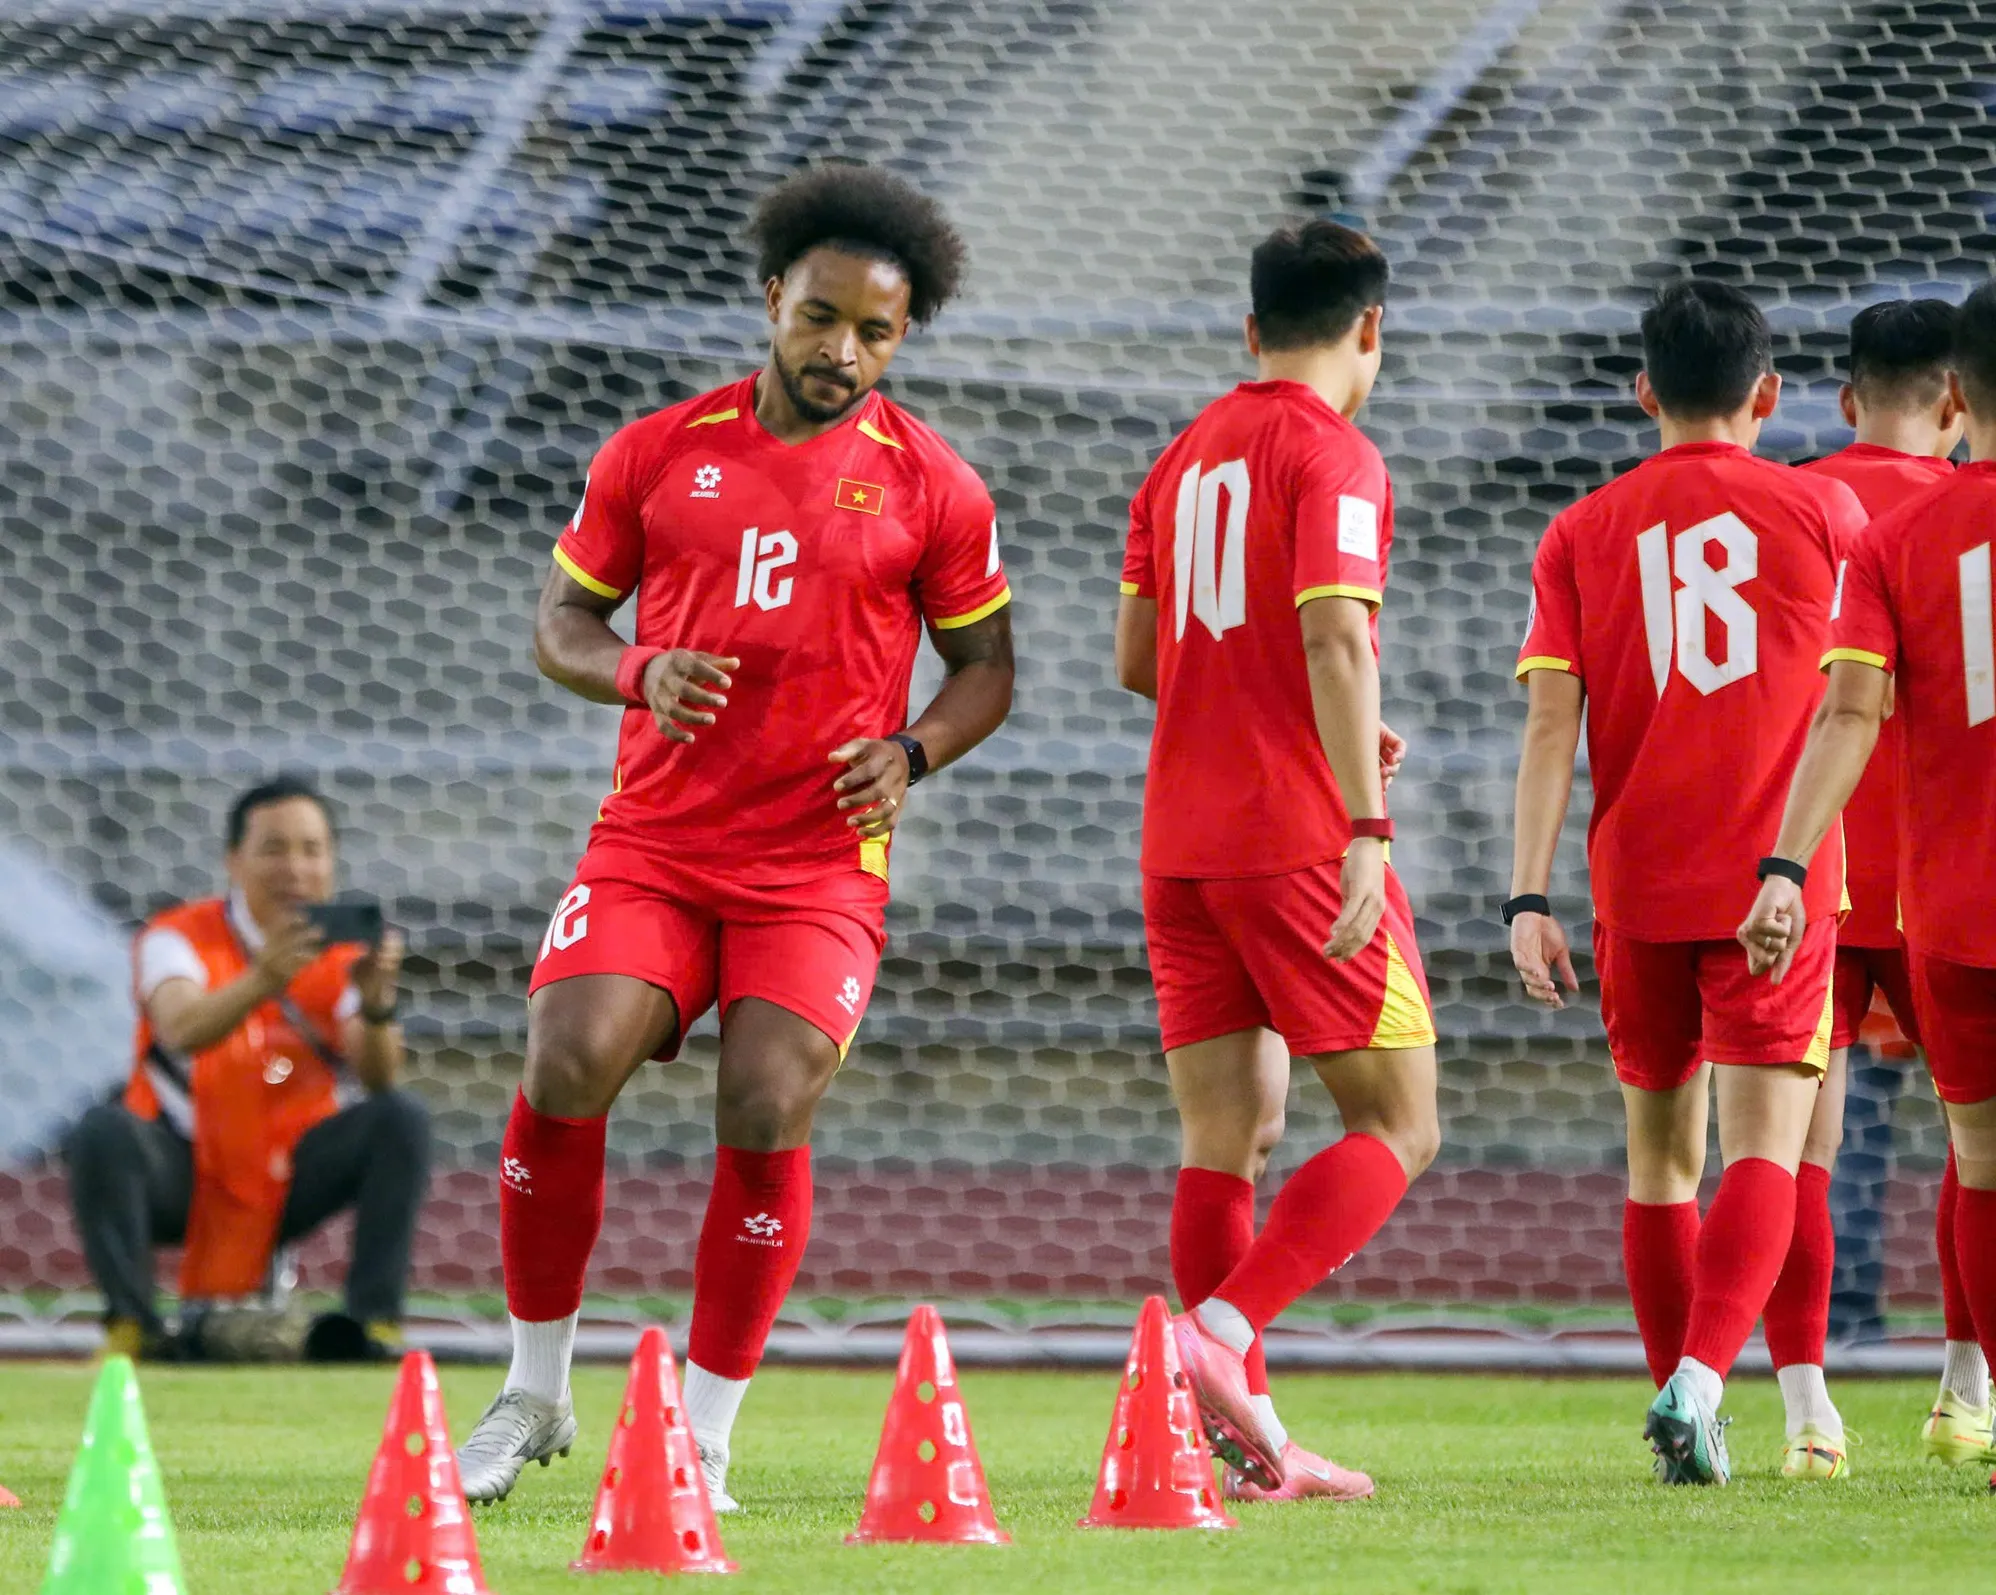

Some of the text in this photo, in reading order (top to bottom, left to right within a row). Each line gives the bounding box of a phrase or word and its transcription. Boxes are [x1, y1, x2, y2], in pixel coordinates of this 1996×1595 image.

[735, 527, 799, 611] 12
[1175, 459, 1251, 643] 10
[1637, 511, 1758, 702] 18
[540, 884, 592, 961] 12
